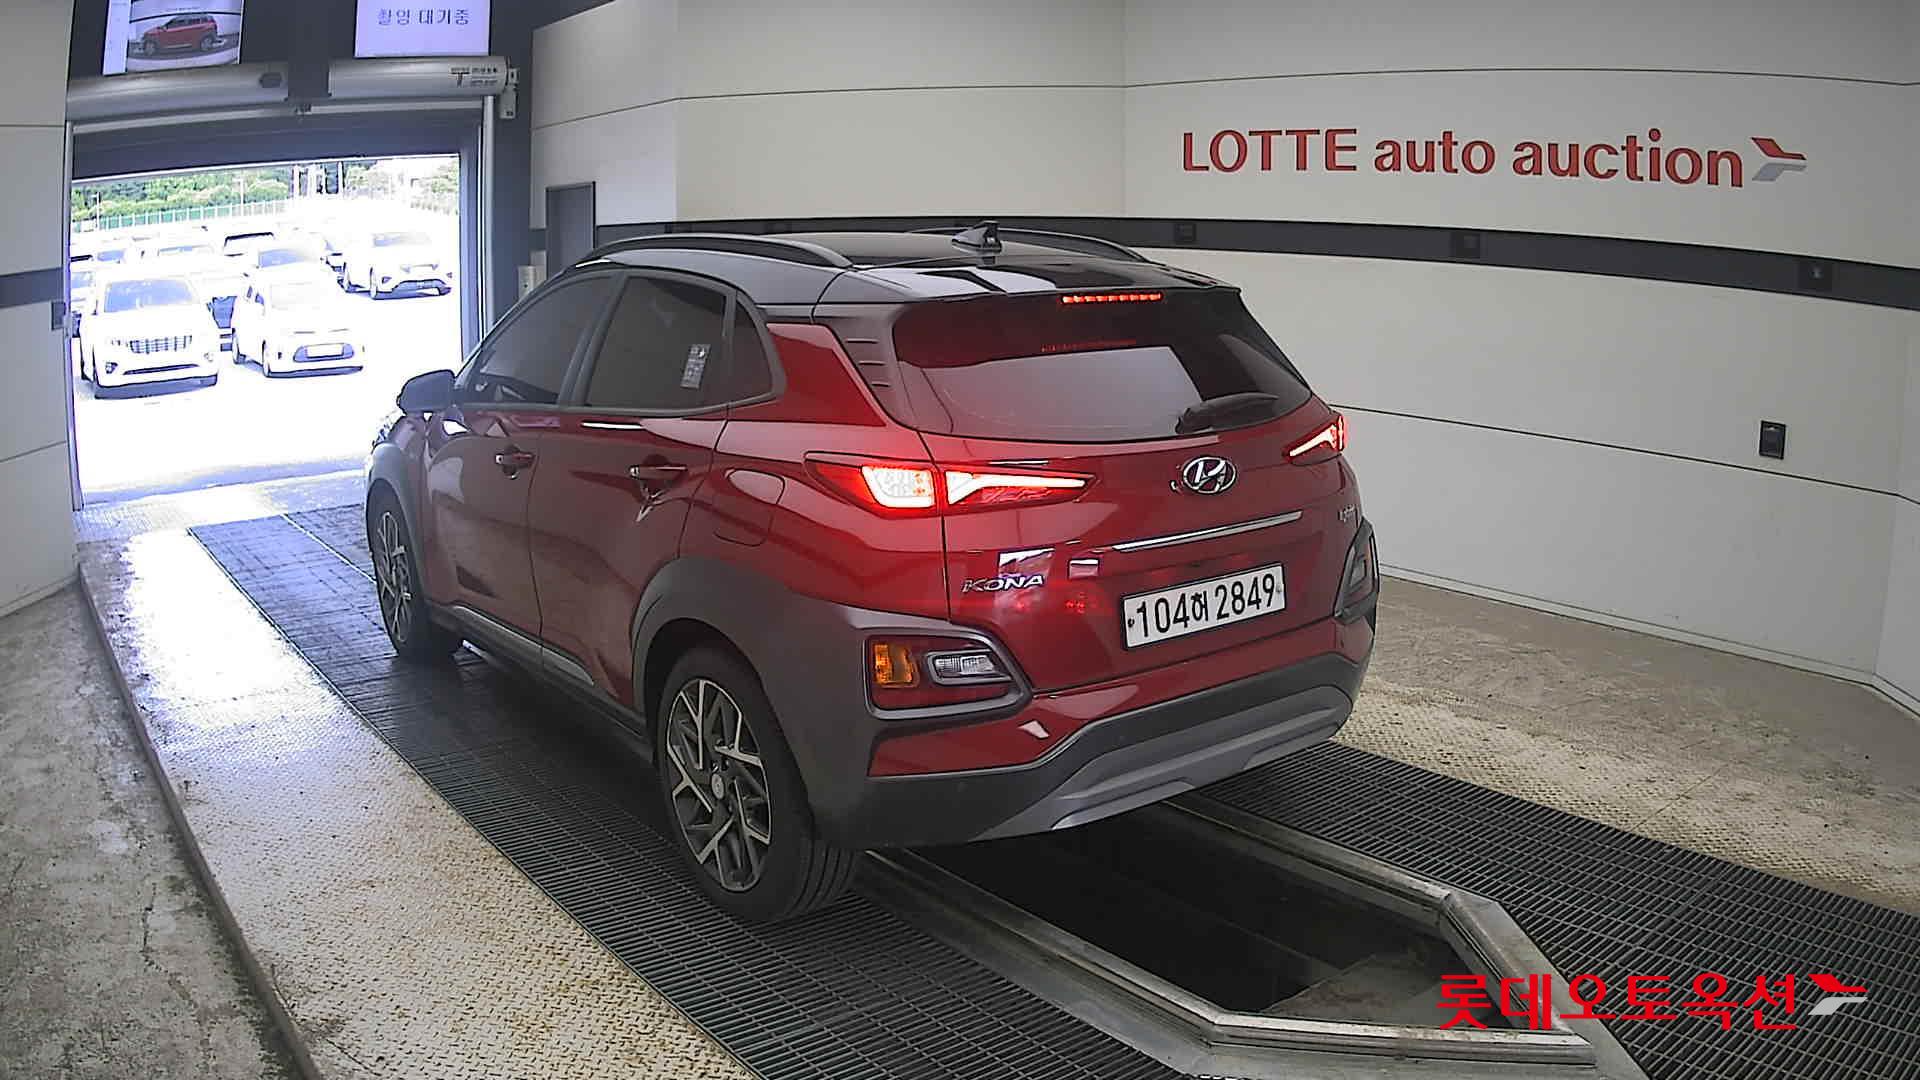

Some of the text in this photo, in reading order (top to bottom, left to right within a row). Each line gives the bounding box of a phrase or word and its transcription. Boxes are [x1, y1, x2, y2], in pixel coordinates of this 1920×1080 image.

[419, 8, 470, 26] 대기중
[1183, 128, 1743, 188] LOTTE auto auction
[962, 574, 1044, 593] KONA
[1214, 573, 1275, 621] 2849
